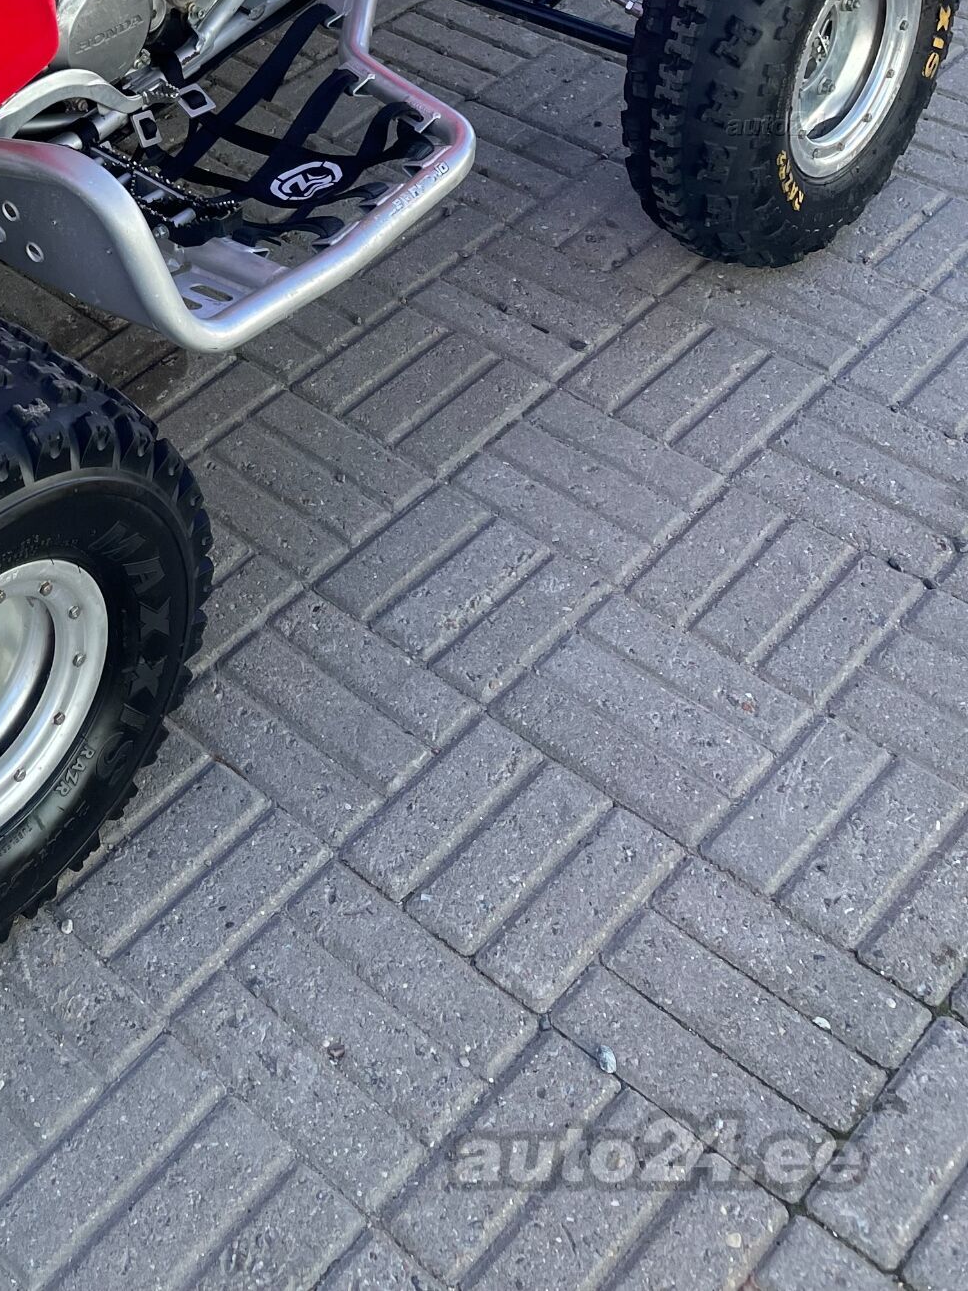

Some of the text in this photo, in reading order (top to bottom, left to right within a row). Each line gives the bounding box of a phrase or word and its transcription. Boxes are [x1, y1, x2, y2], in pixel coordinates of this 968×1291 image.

[75, 14, 145, 55] HONDA
[88, 520, 172, 788] MAXXIS
[55, 743, 96, 797] RAZR
